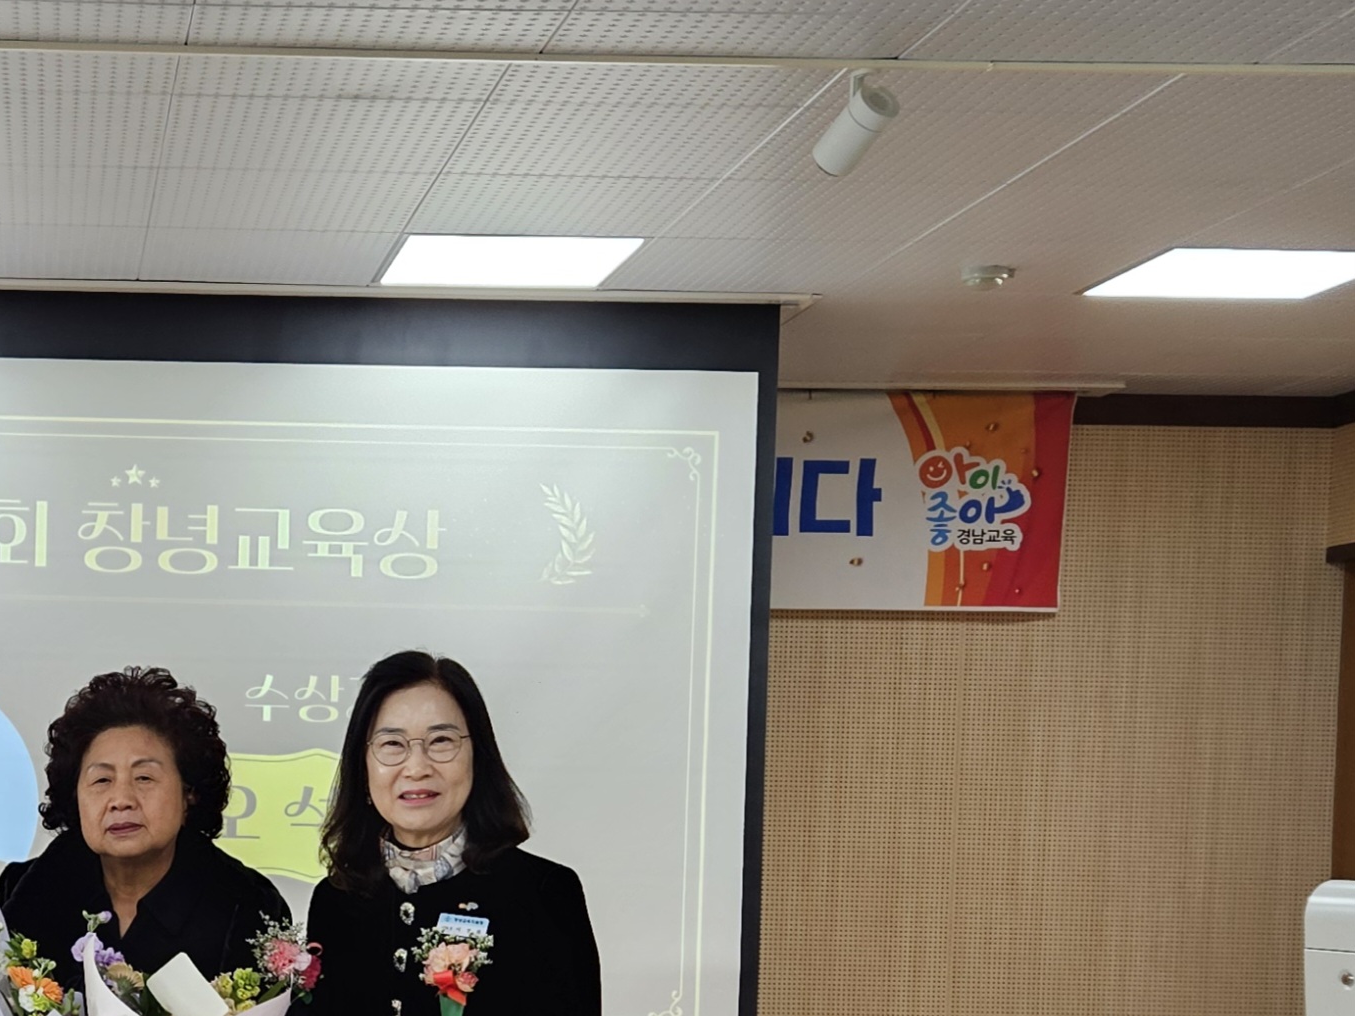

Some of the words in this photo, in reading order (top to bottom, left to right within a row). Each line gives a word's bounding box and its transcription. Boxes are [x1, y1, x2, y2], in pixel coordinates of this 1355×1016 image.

[772, 457, 882, 536] 다
[919, 452, 1000, 490] 아이
[78, 502, 447, 579] 창녕교육상
[926, 486, 1025, 546] 좋아
[957, 529, 1017, 545] 경남교육
[245, 674, 360, 722] 수상
